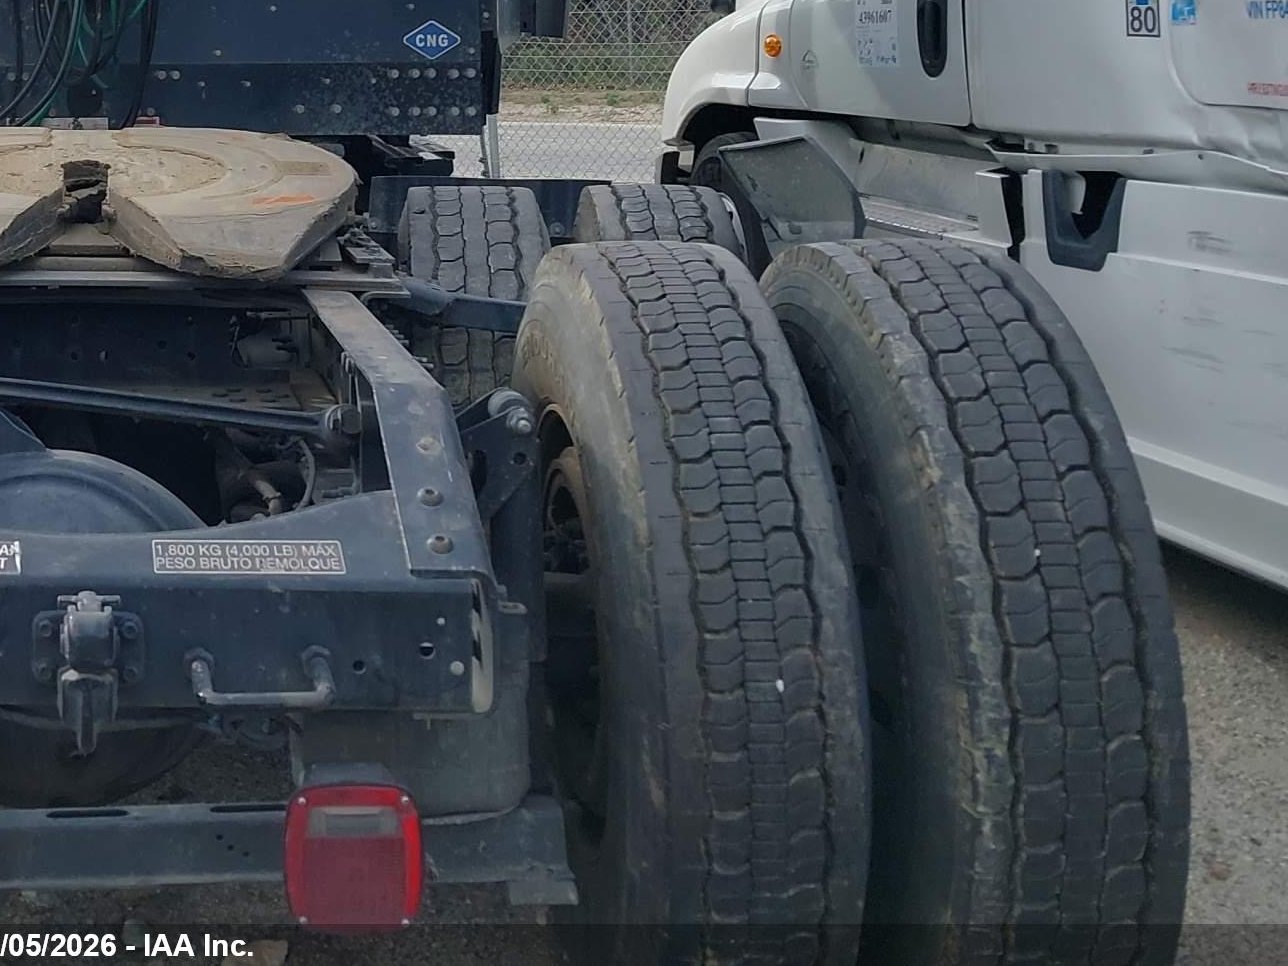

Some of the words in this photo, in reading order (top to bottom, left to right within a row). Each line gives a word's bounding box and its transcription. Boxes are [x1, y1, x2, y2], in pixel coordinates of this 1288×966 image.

[1246, 0, 1263, 19] VIN
[1130, 6, 1157, 33] 80
[415, 33, 449, 47] CNG
[156, 544, 195, 558] 1,800
[199, 545, 221, 556] KG
[274, 545, 298, 558] LB)
[157, 557, 196, 569] PESO
[200, 557, 252, 570] BRUTO
